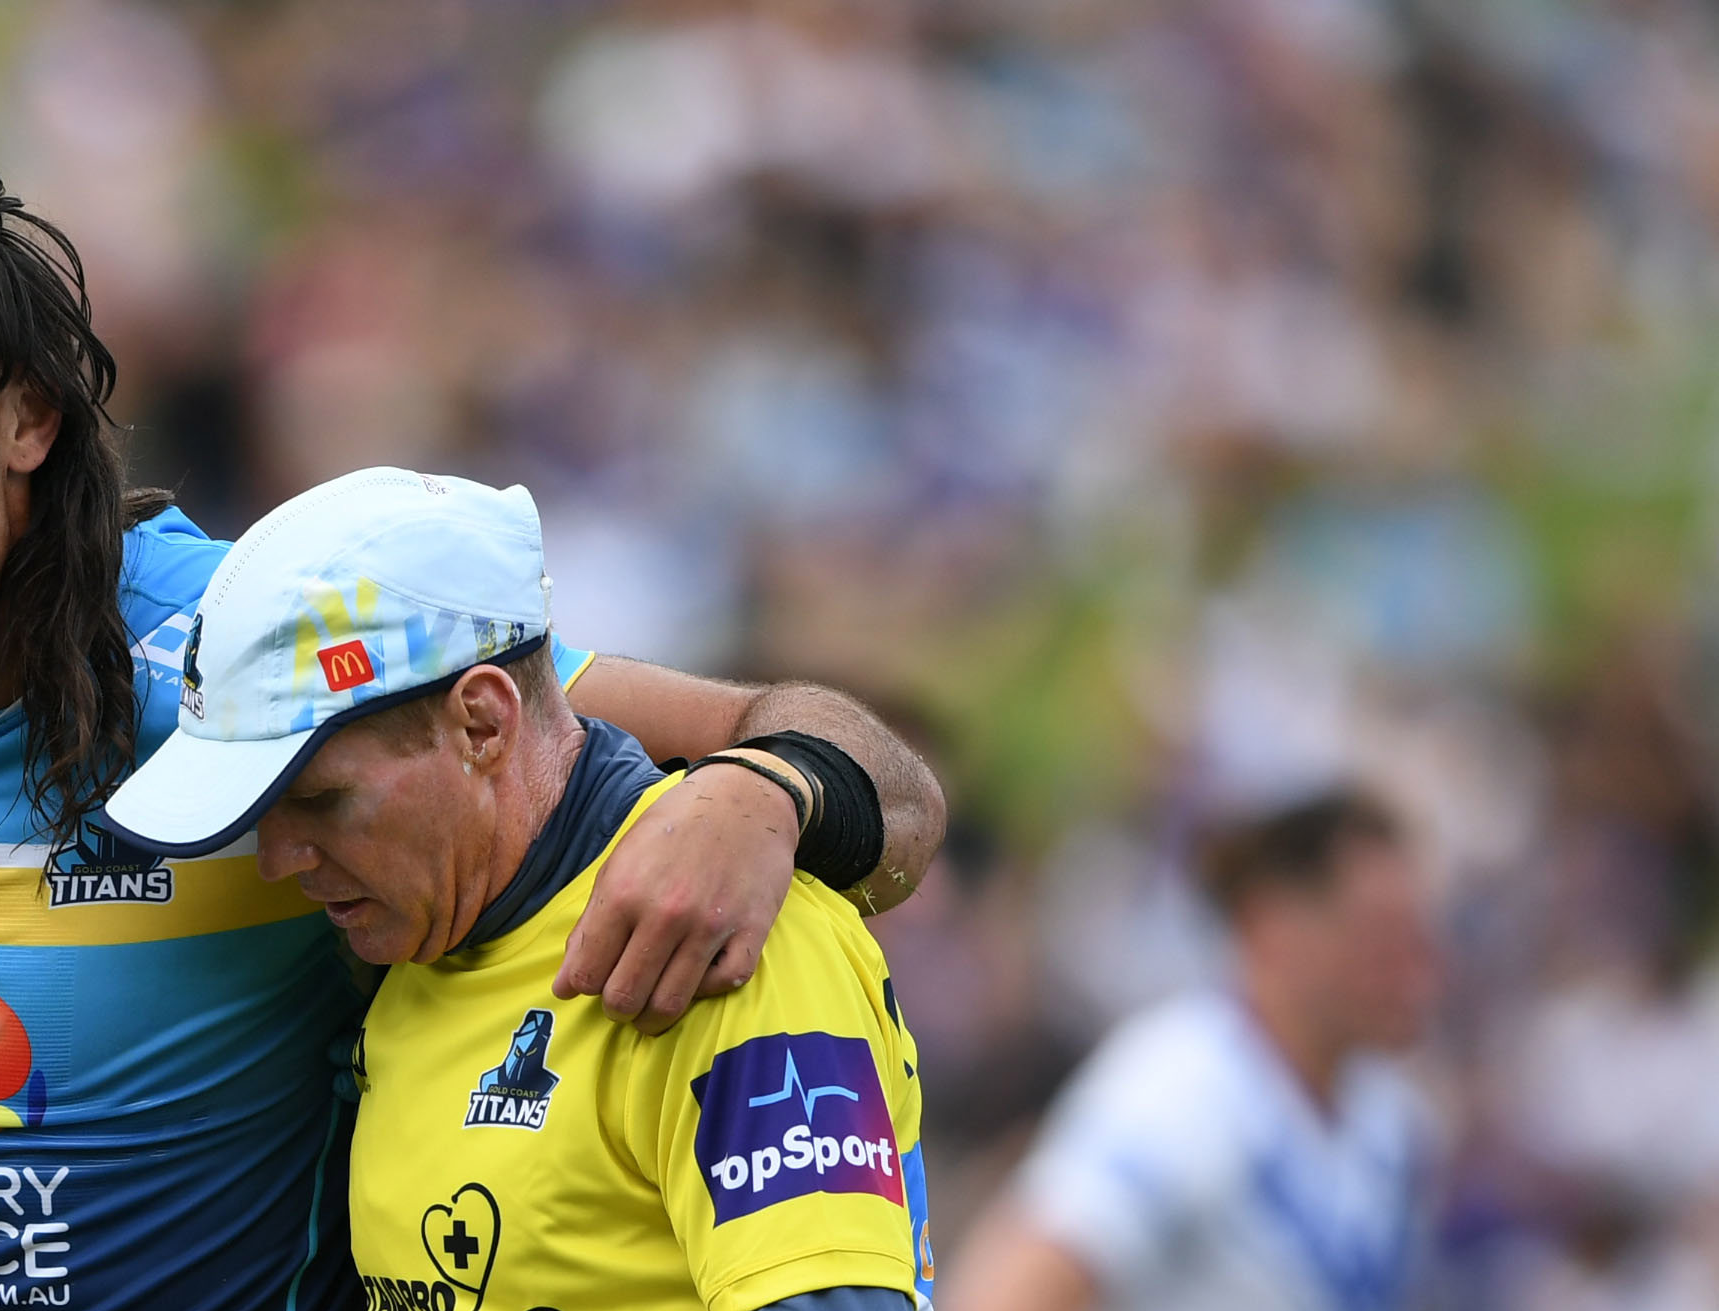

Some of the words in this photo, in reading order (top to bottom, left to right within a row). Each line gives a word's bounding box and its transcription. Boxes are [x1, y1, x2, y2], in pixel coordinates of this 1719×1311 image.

[74, 866, 102, 875] GOLD
[105, 864, 140, 873] COAST
[50, 871, 168, 903] TITANS
[488, 1086, 509, 1095] GOLD
[510, 1088, 540, 1099] COAST
[467, 1094, 549, 1127] TITANS
